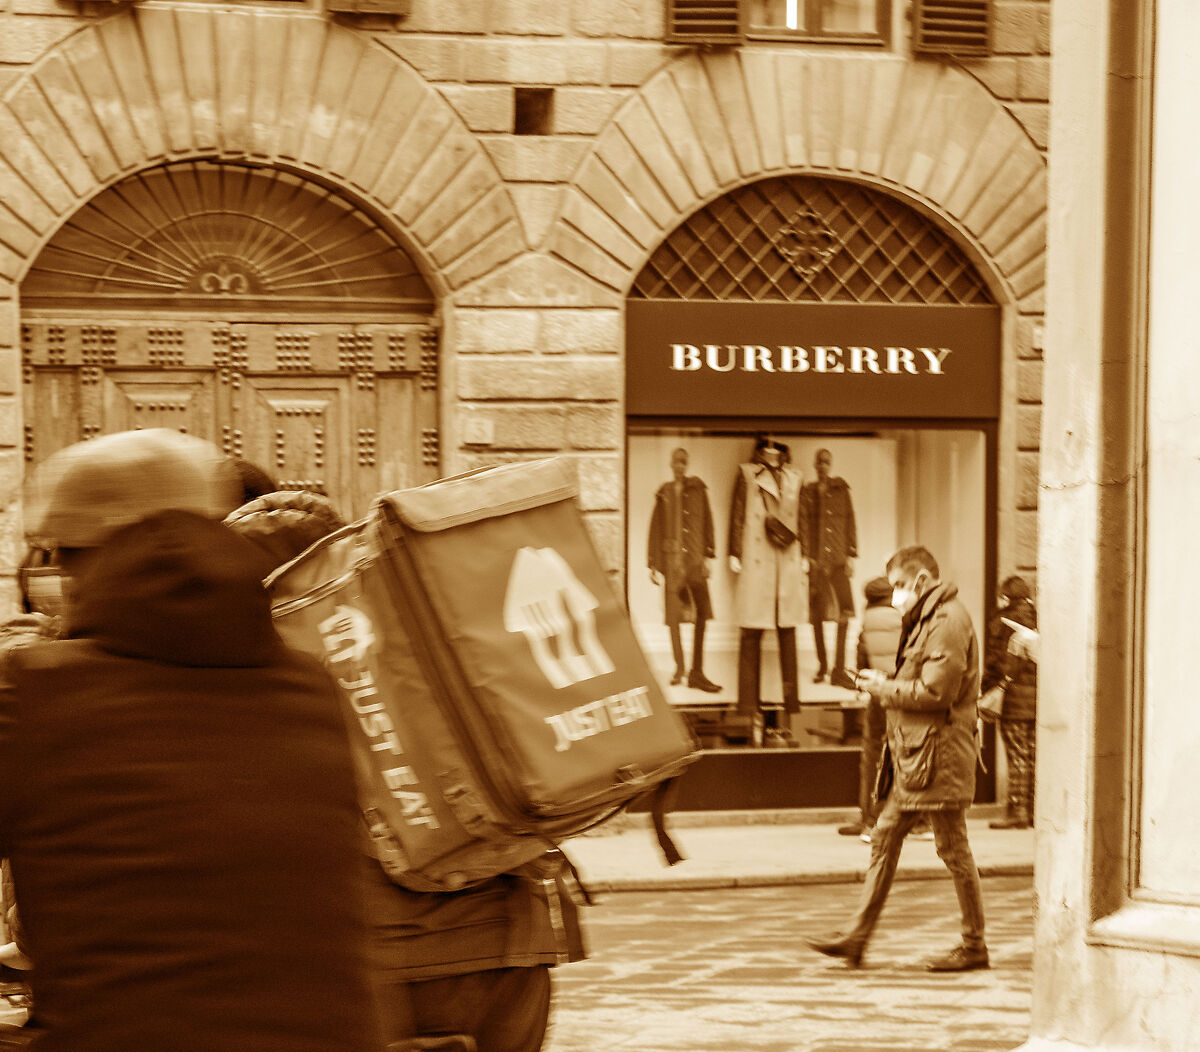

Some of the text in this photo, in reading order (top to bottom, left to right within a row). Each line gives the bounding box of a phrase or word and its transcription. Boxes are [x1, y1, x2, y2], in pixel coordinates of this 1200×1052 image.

[668, 343, 953, 375] BURBERRY
[337, 669, 441, 831] JUST EAT
[544, 685, 656, 753] JUST EAT
